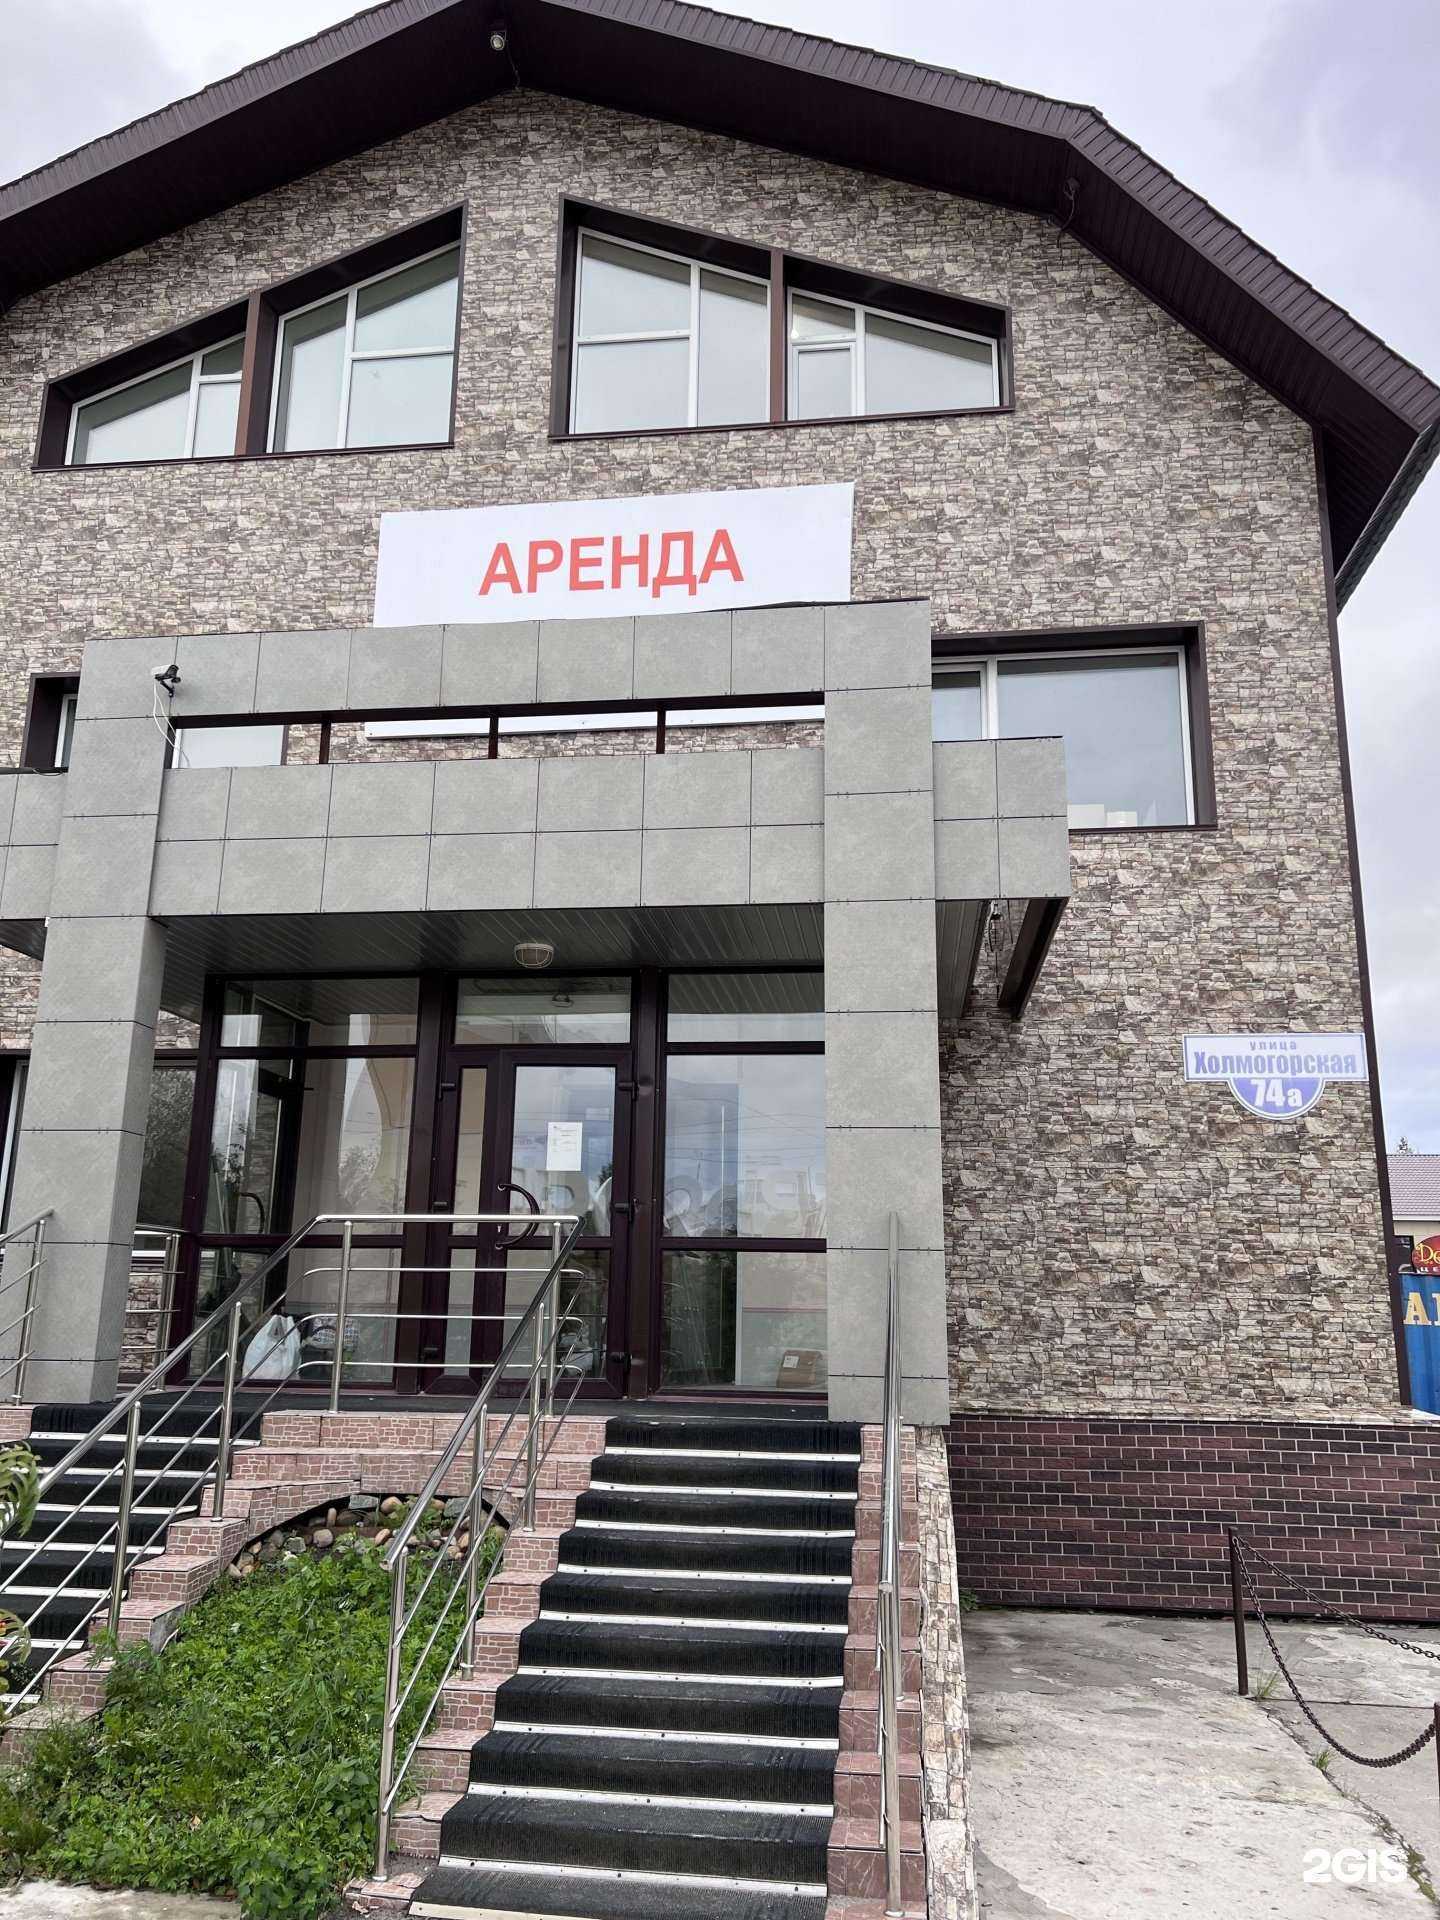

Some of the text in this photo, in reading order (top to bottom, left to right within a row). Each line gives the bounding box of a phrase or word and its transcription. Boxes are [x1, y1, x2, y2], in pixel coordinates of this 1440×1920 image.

[479, 529, 744, 598] АРЕНДА
[1249, 1041, 1297, 1051] улица
[1194, 1051, 1357, 1076] Холмогорская
[1251, 1079, 1303, 1107] 74а
